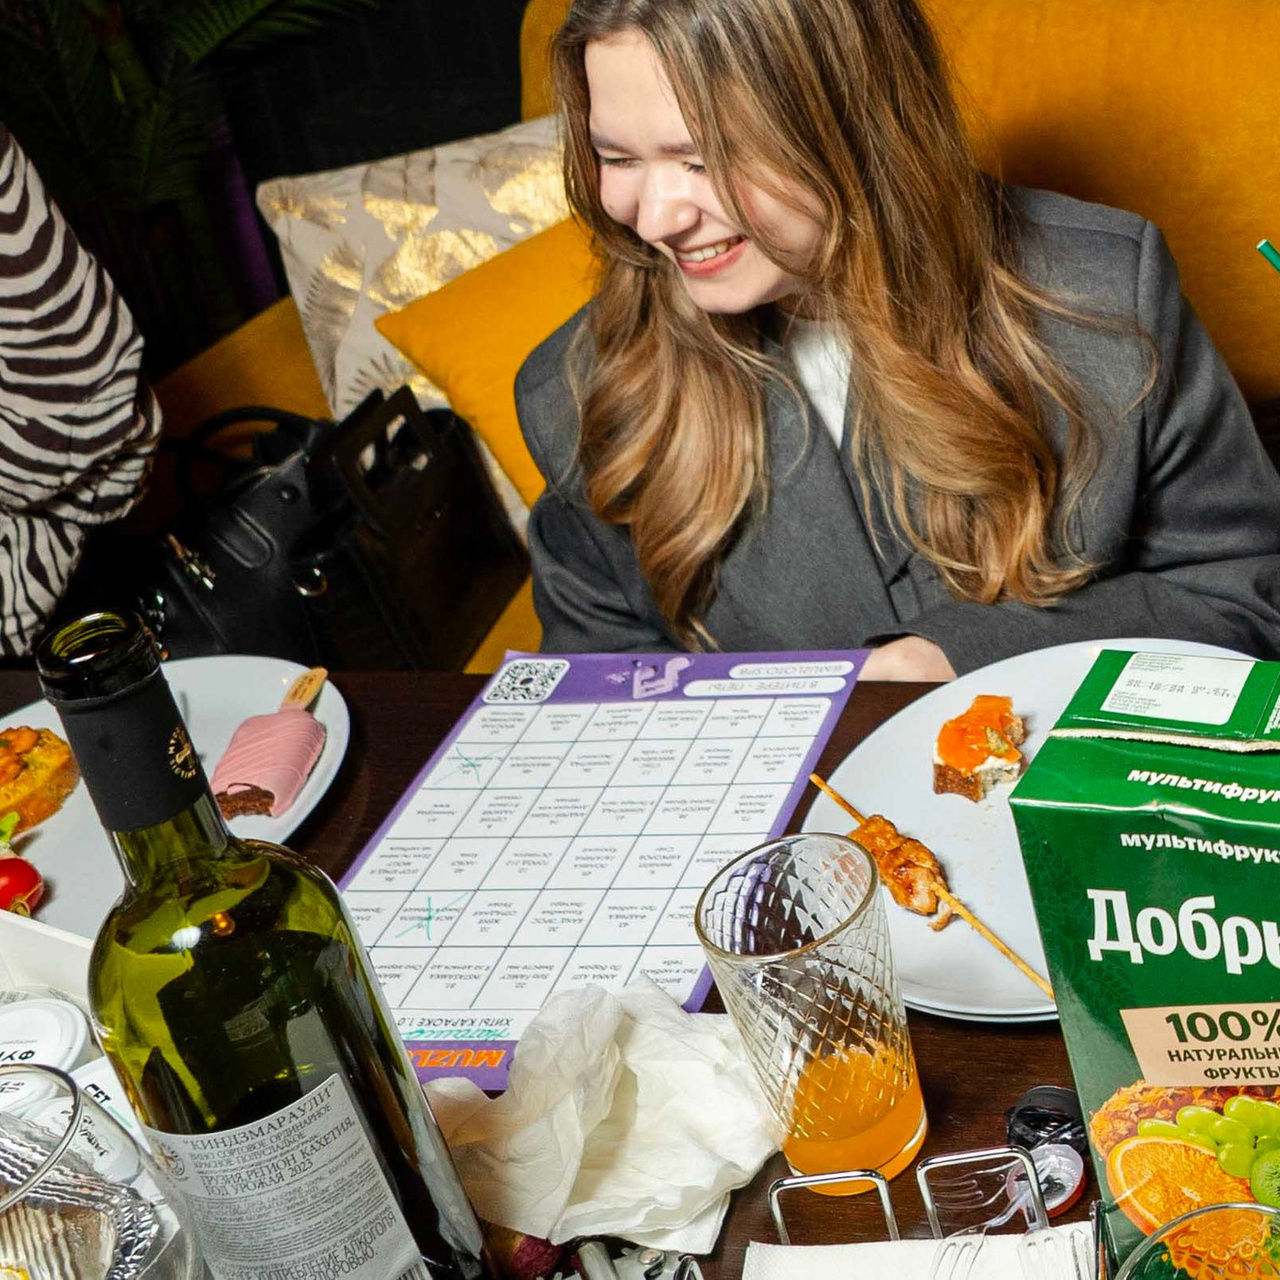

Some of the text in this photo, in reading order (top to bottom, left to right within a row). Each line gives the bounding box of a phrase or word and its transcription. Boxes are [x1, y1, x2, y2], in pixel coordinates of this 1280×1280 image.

[757, 681, 808, 691] ПИТЕРЕ
[397, 1018, 513, 1026] ХИТЫ КАРАОКЕ 1.0
[407, 1049, 506, 1067] MUZL
[269, 1104, 332, 1147] ОРДИНАРНОЕ
[237, 1132, 306, 1165] ПОЛУСЛАДКОЕ
[205, 1159, 314, 1196] ГОД УРОЖАЯ 2023
[247, 1155, 297, 1181] РЕГИОН
[344, 1211, 397, 1255] АЛКОГОЛЯ
